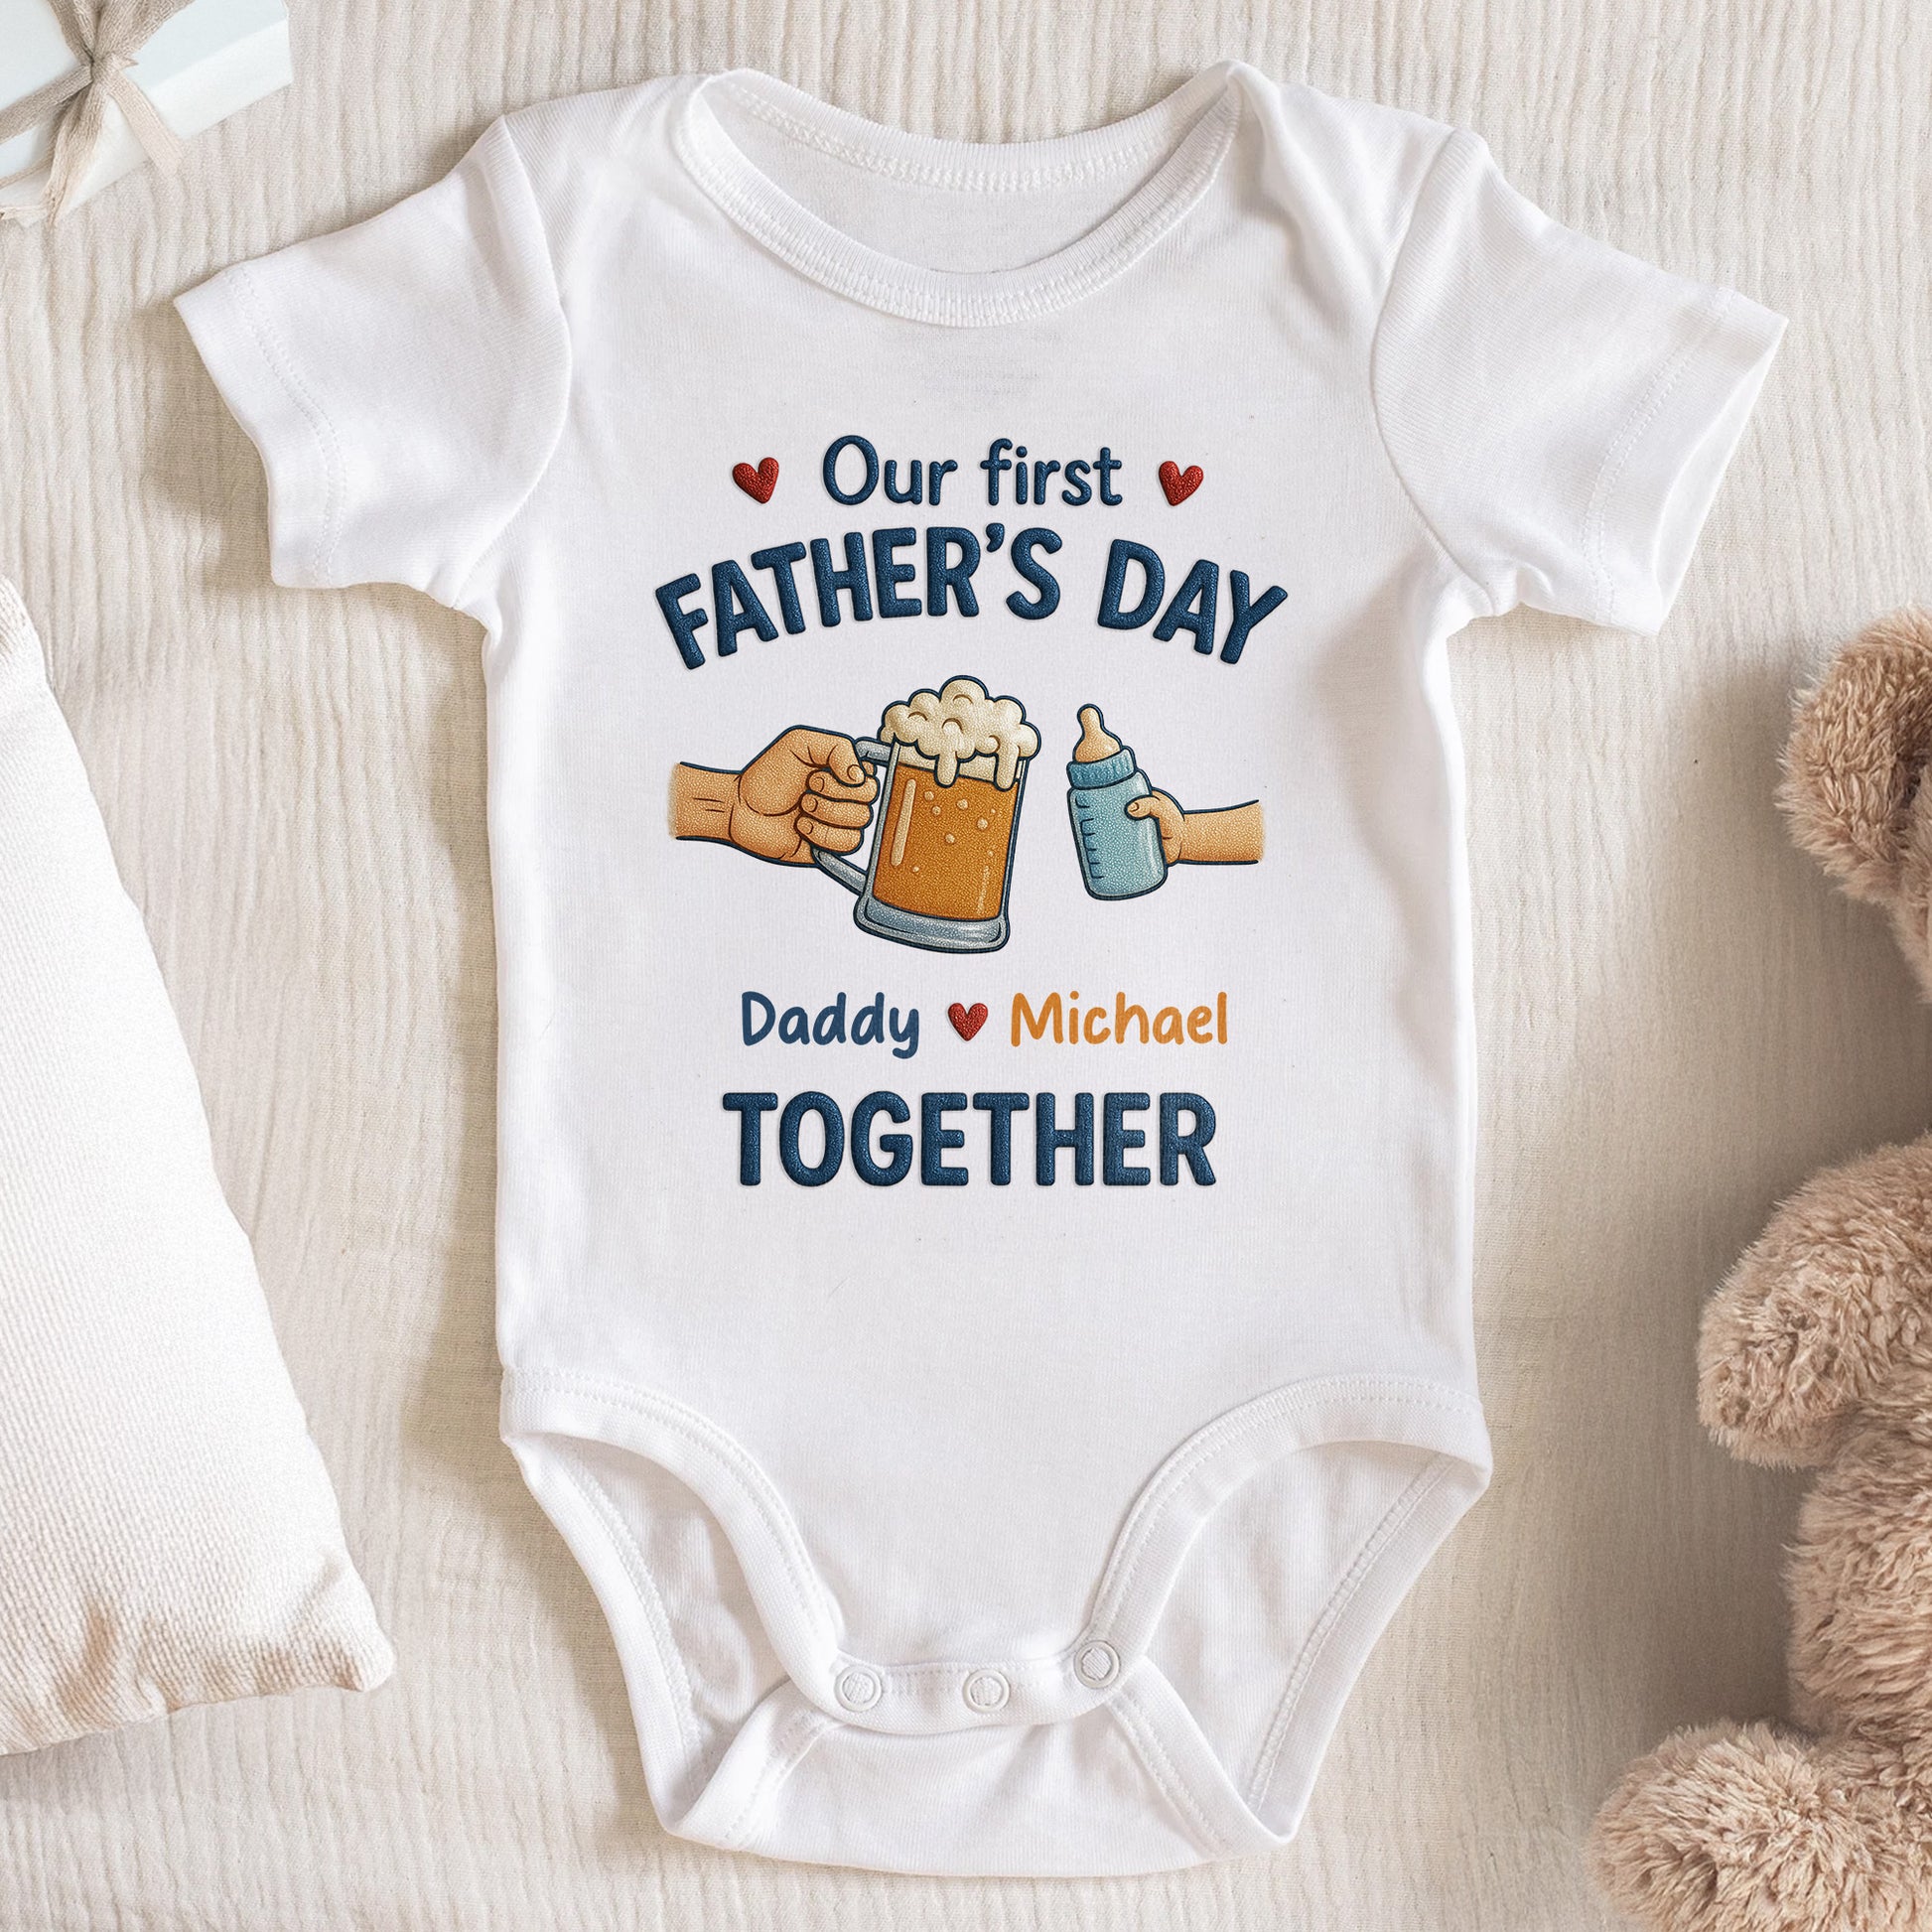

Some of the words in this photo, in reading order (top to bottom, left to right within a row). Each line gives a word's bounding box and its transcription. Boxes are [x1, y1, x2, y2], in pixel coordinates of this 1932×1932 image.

[823, 435, 958, 506] Our
[980, 438, 1123, 507] first
[655, 523, 1063, 670] FATHER’S
[1098, 539, 1289, 665] DAY
[742, 991, 919, 1059] Daddy
[1012, 991, 1228, 1047] Michael
[723, 1091, 1216, 1187] TOGETHER
